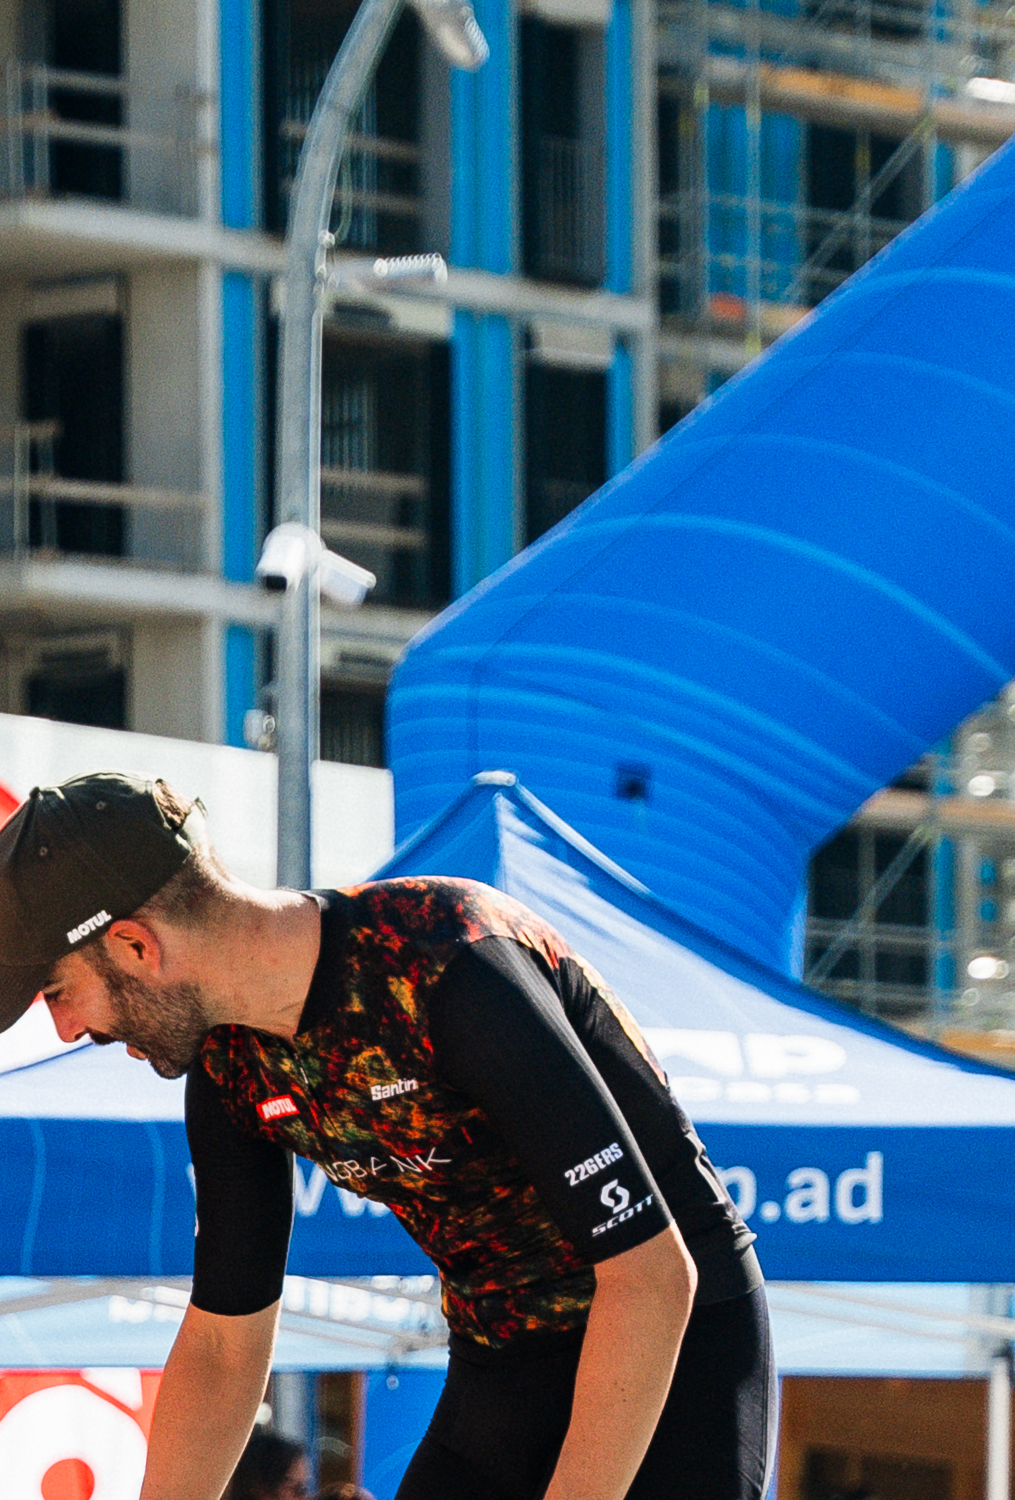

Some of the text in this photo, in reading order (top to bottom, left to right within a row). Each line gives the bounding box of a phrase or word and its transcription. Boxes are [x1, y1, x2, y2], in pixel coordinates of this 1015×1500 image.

[67, 909, 112, 944] MOTUL
[262, 1097, 297, 1119] MOTUL
[564, 1142, 624, 1187] 226ERS
[591, 1193, 654, 1238] SCOTT
